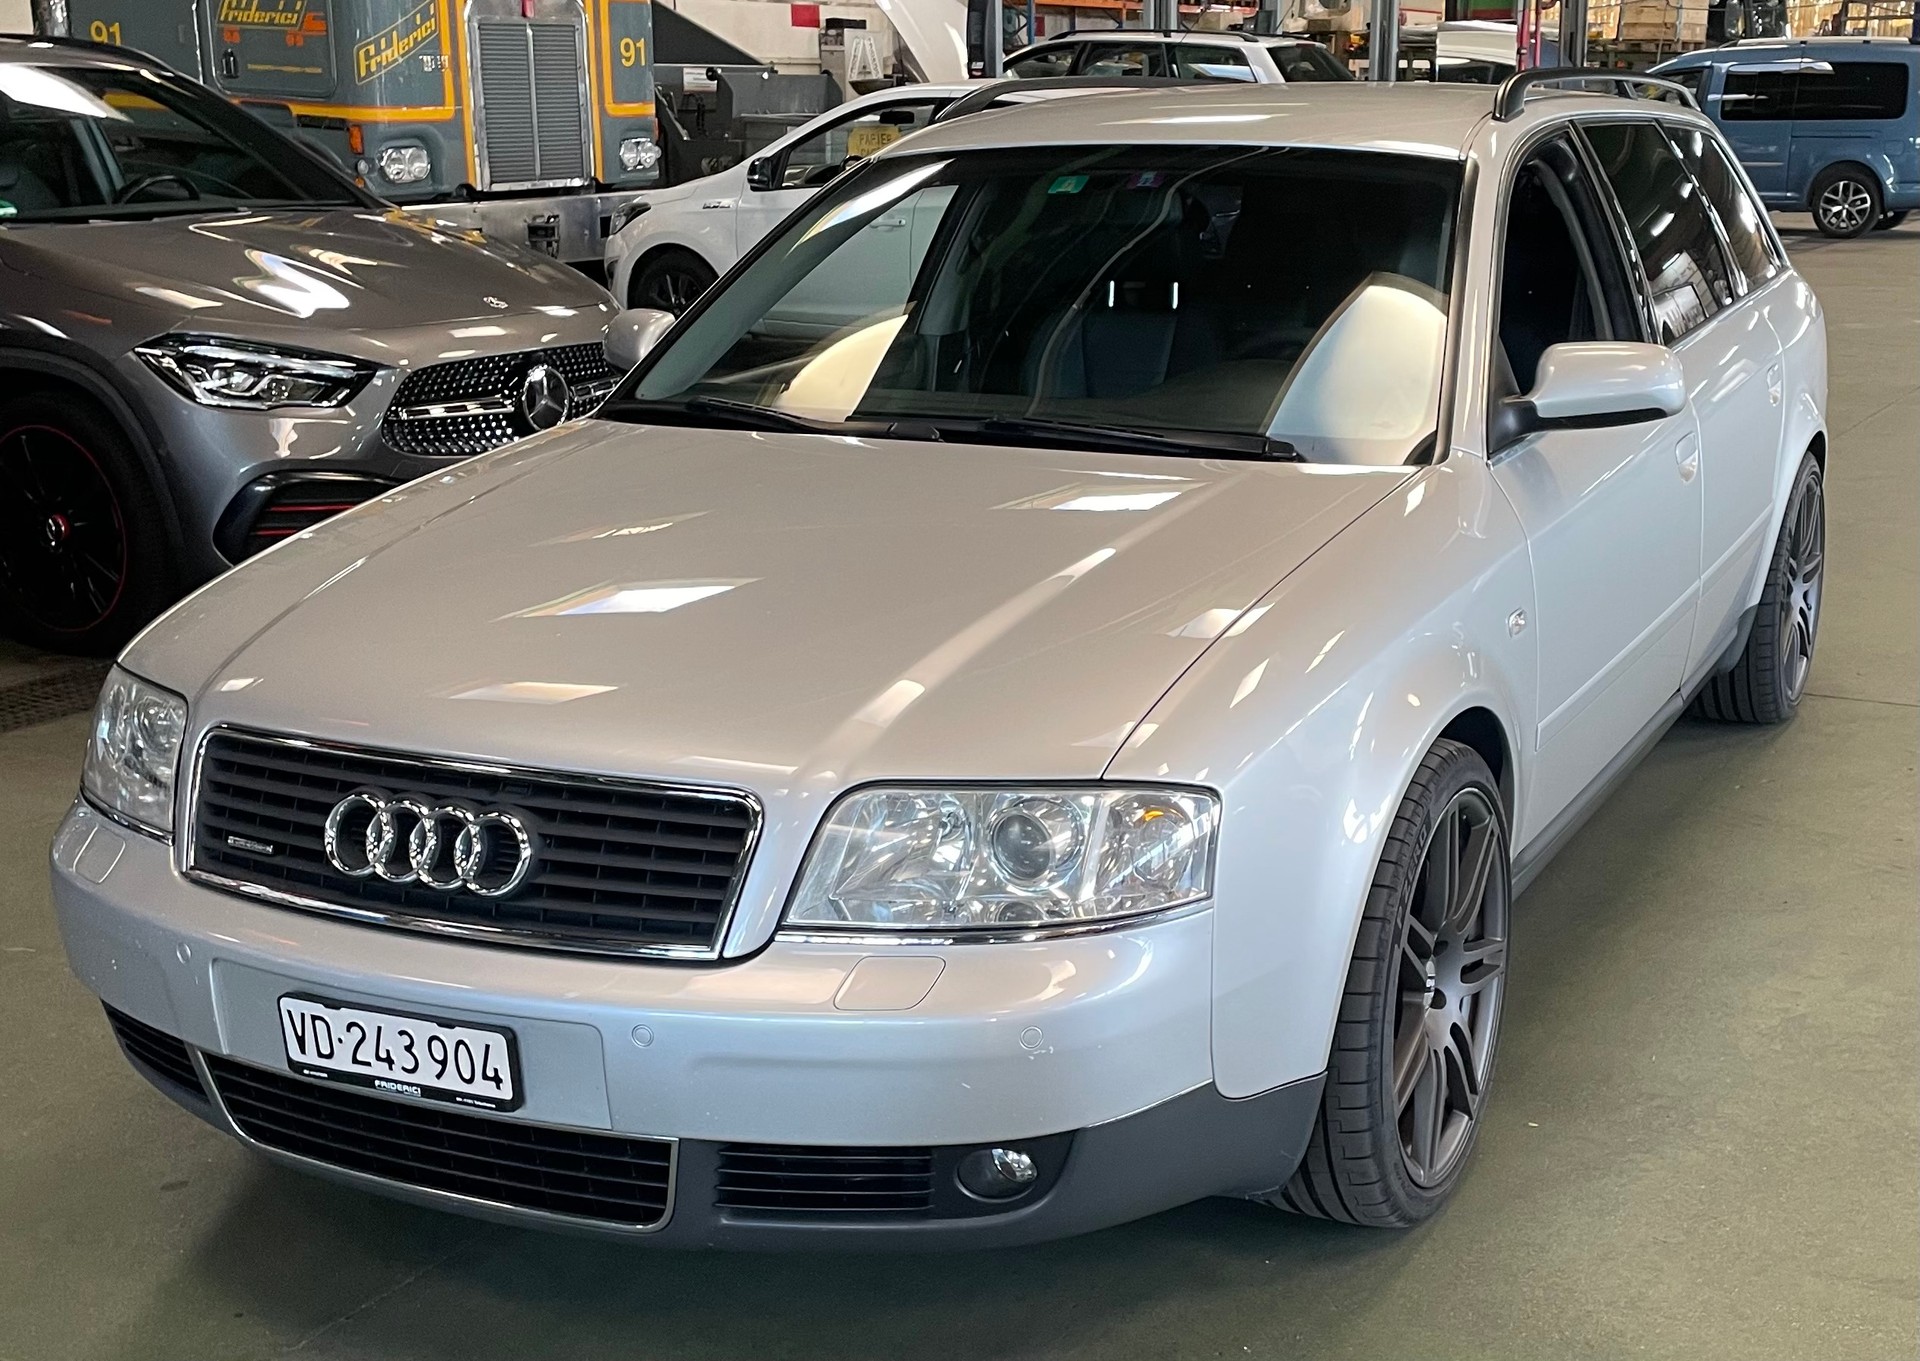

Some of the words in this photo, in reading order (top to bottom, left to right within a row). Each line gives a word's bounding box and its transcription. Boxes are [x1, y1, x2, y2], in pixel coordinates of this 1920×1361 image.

[90, 20, 121, 47] 91
[359, 3, 436, 78] Friderici
[620, 37, 646, 67] 91
[374, 1079, 421, 1094] FRIDERICI
